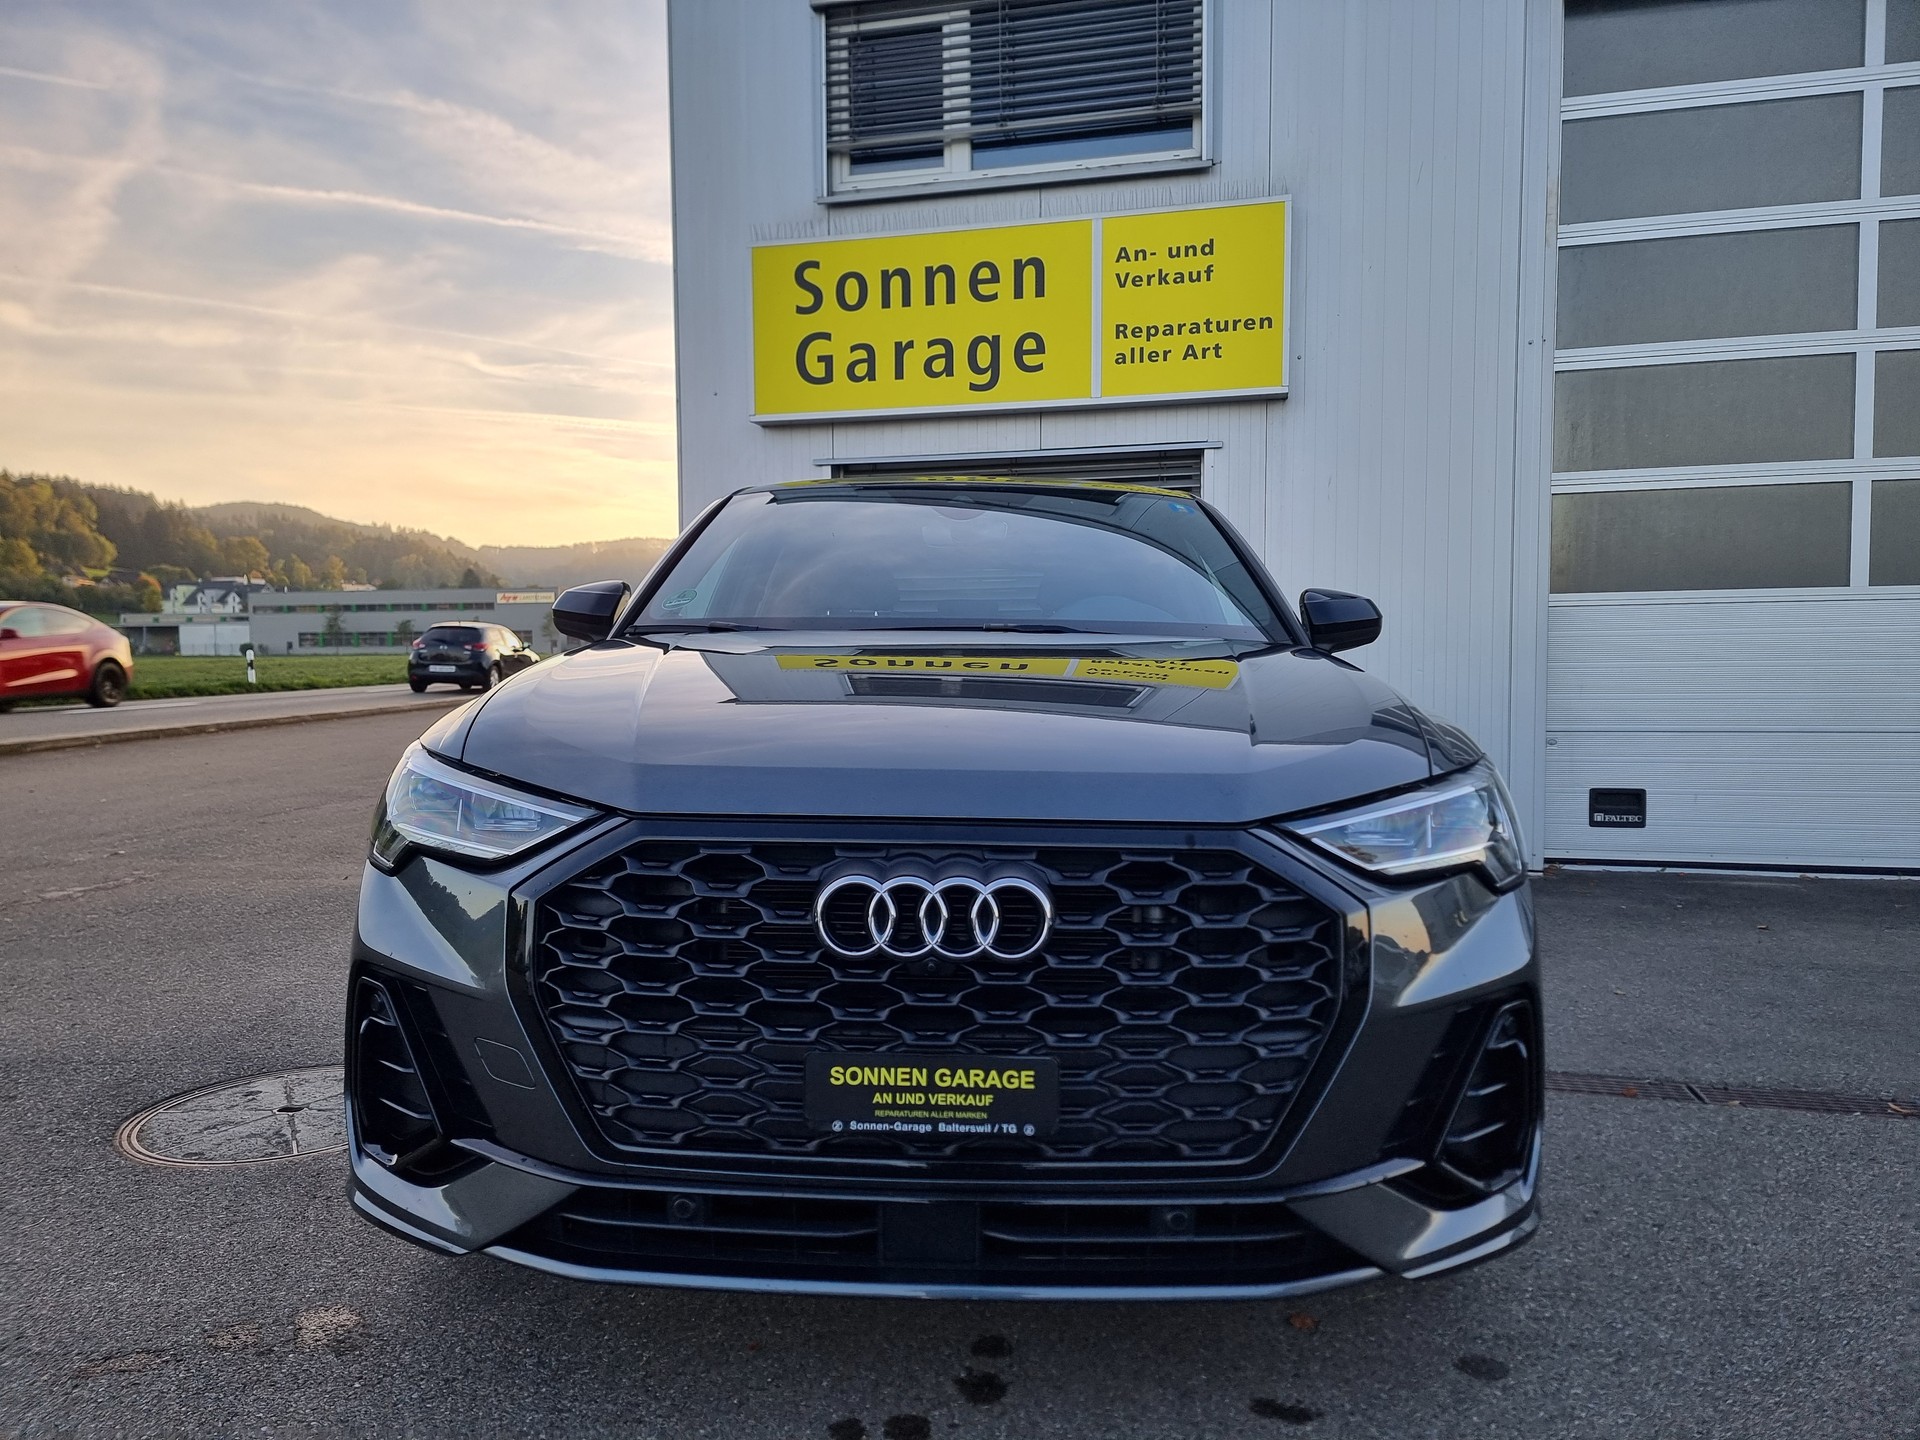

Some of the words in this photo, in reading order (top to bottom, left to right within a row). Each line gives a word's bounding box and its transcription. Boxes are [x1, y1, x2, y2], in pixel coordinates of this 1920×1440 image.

[1114, 246, 1157, 264] An-
[1167, 238, 1216, 259] und
[793, 253, 1047, 315] Sonnen
[1114, 264, 1215, 289] Verkauf
[1114, 315, 1274, 342] Reparaturen
[794, 329, 1047, 393] Garage
[1113, 345, 1172, 366] aller
[1181, 342, 1223, 362] Art
[1604, 814, 1643, 823] FALTEC
[829, 1066, 928, 1087] SONNEN
[934, 1068, 1035, 1089] GARAGE
[872, 1092, 893, 1105] AN
[896, 1093, 925, 1106] UND
[928, 1093, 995, 1107] VERKAUF
[874, 1109, 930, 1119] REPARATUREN
[930, 1110, 954, 1119] ALLER
[955, 1111, 988, 1120] MARKEN
[849, 1120, 933, 1134] Sonnen-Garage
[938, 1122, 992, 1134] Balterswil
[1001, 1123, 1018, 1135] TG
